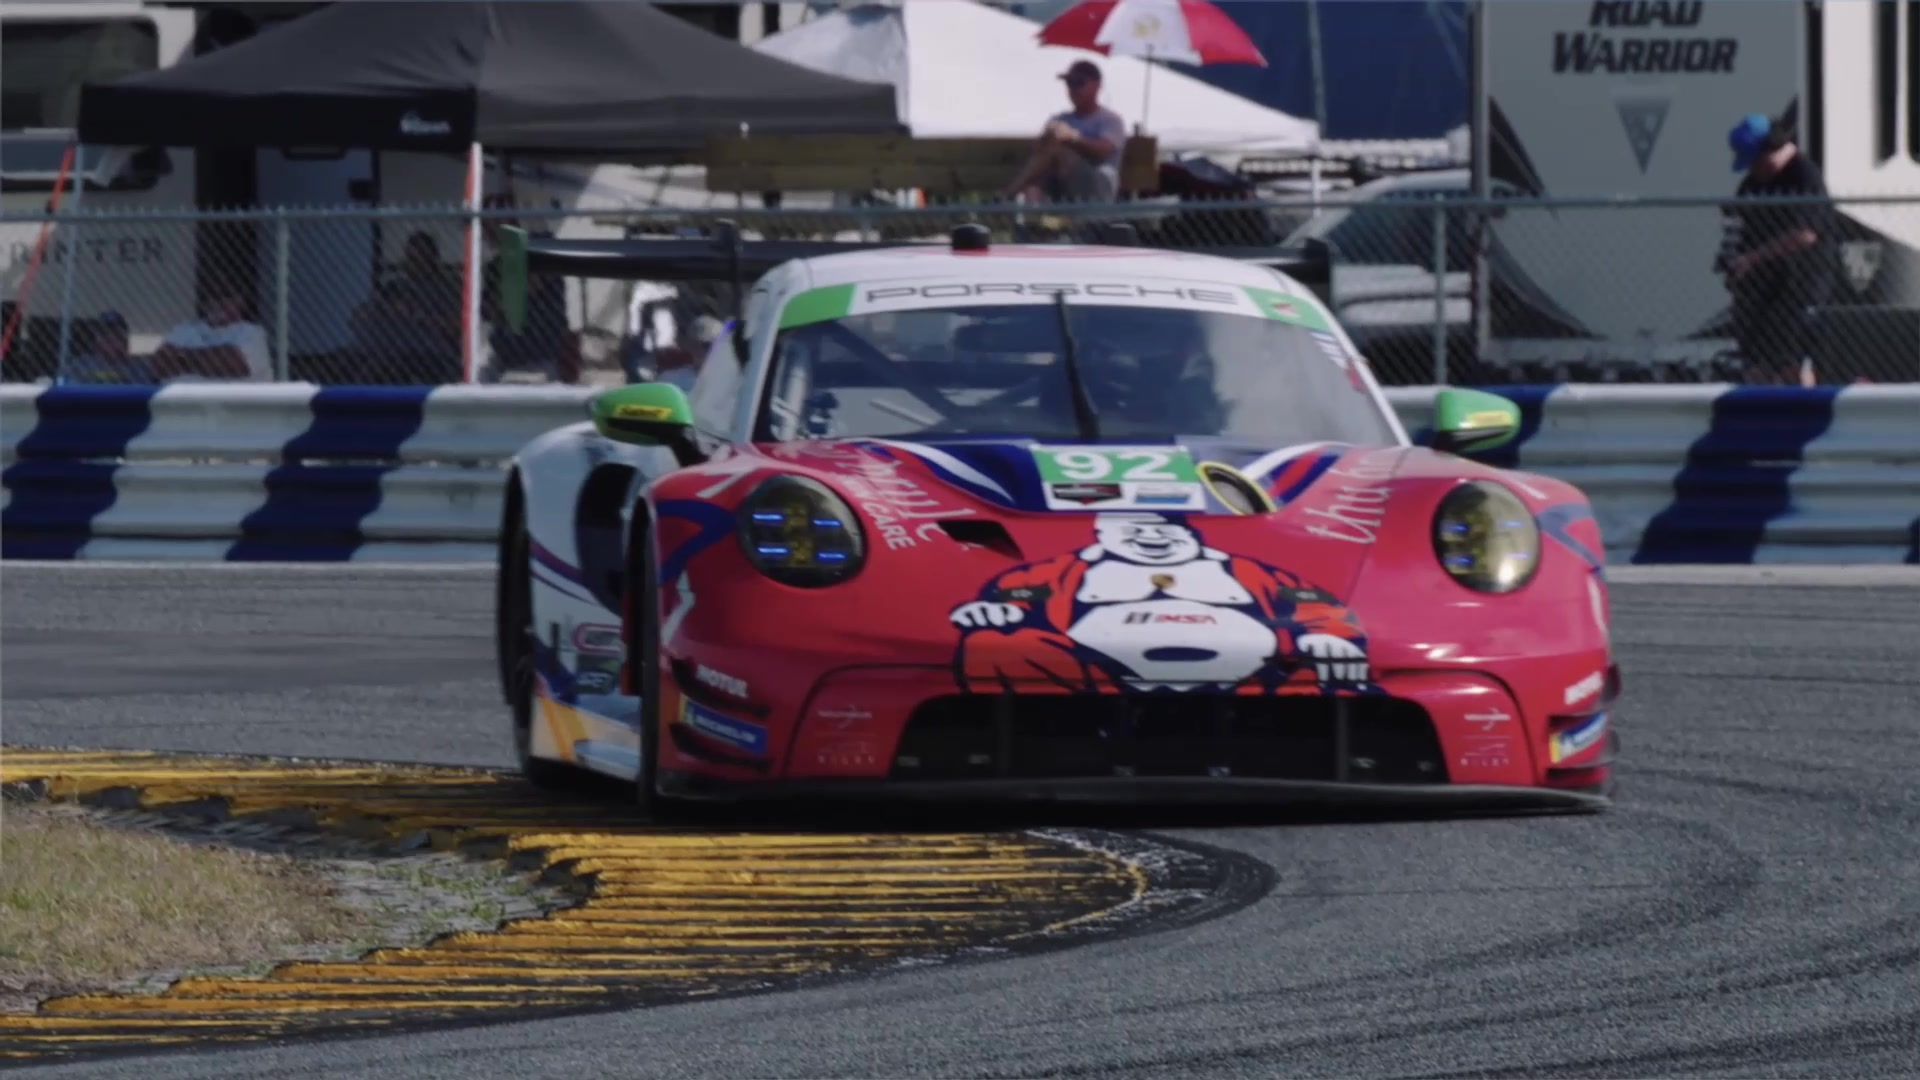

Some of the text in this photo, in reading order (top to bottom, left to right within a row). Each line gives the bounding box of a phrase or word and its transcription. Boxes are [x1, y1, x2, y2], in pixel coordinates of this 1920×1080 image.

[1590, 0, 1703, 27] ROAD
[1552, 31, 1738, 74] WARRIOR
[866, 283, 1237, 304] PORSCHE
[1053, 451, 1178, 480] 92
[862, 501, 917, 550] CARE
